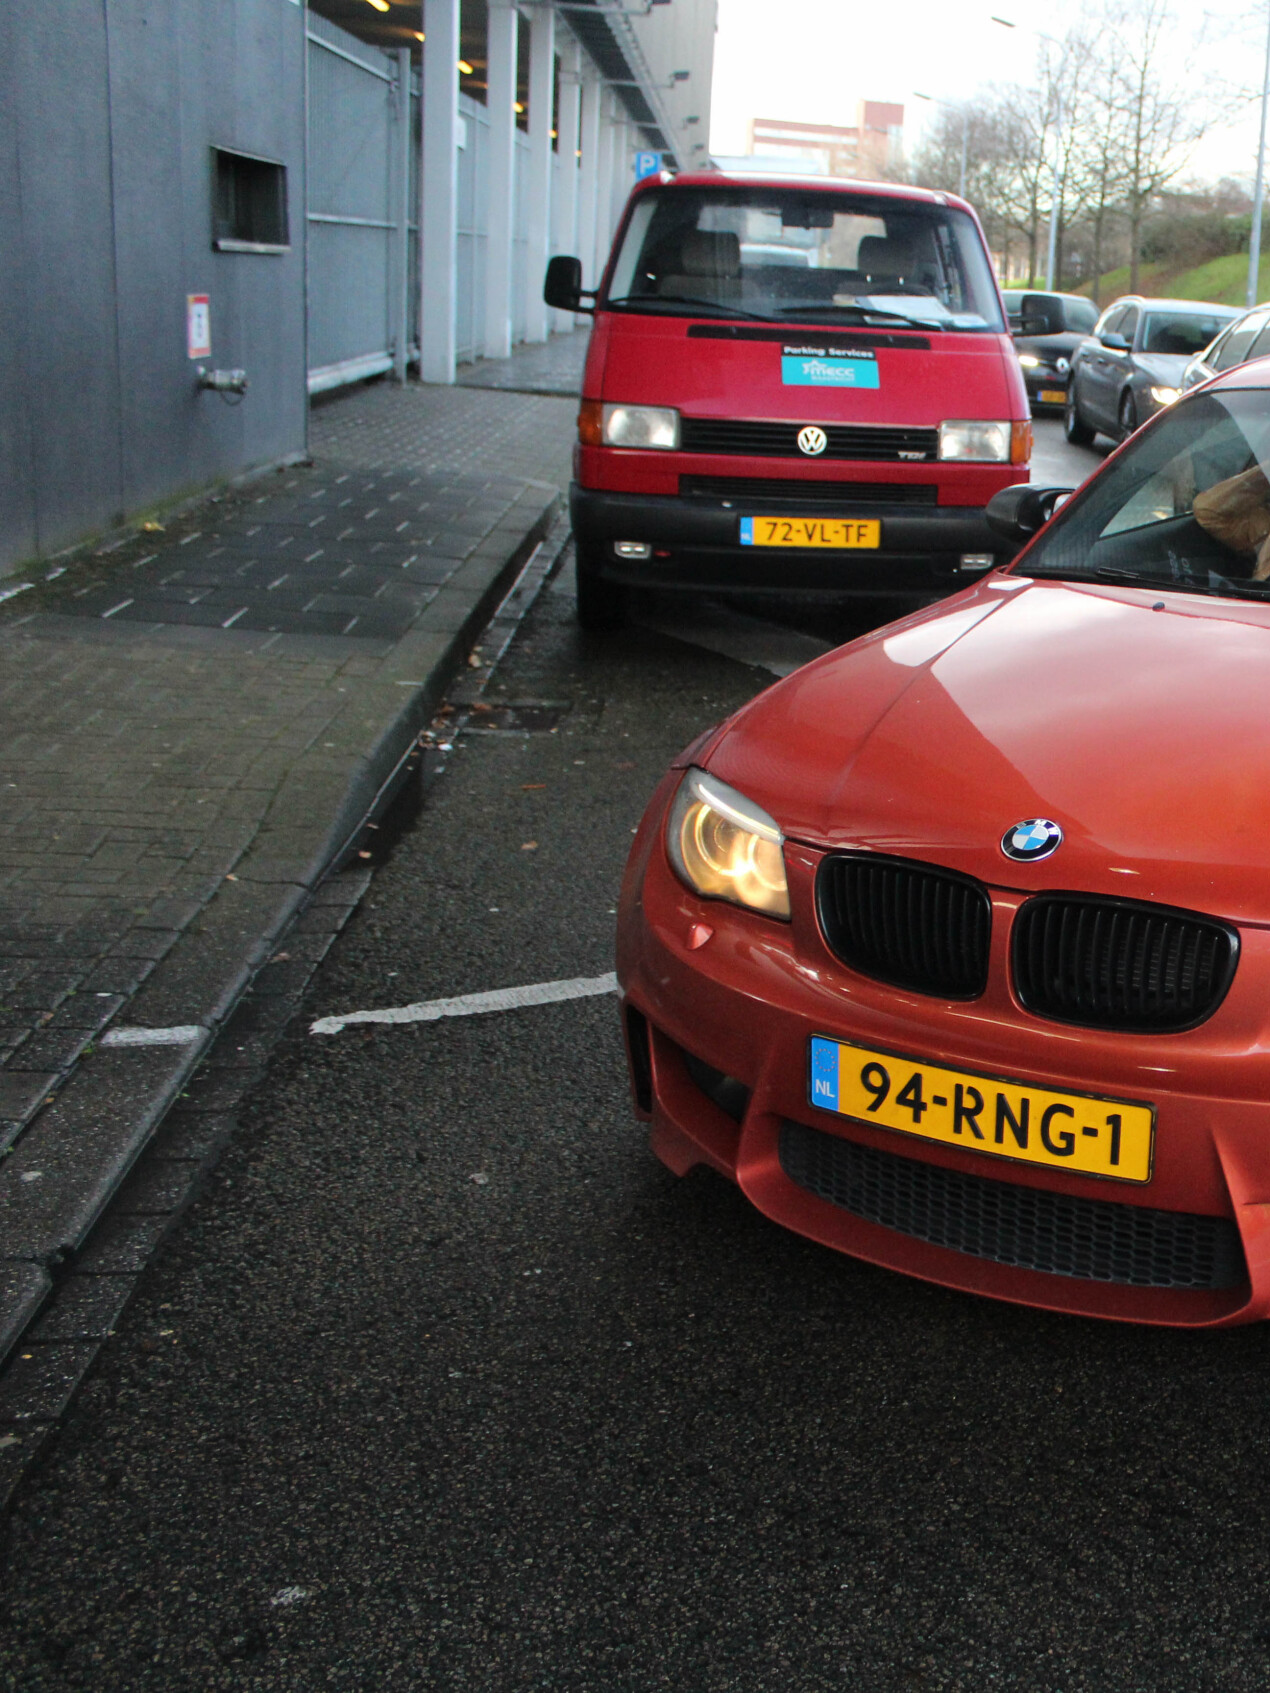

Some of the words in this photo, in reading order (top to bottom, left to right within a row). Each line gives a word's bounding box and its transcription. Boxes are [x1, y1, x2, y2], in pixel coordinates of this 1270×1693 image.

[640, 154, 656, 175] P
[783, 345, 826, 357] Parking
[828, 347, 874, 359] Services
[765, 521, 869, 544] 72-VL-TF
[1015, 818, 1060, 836] BMW
[815, 1078, 836, 1099] NL
[860, 1061, 1122, 1166] 94-RNG-1
